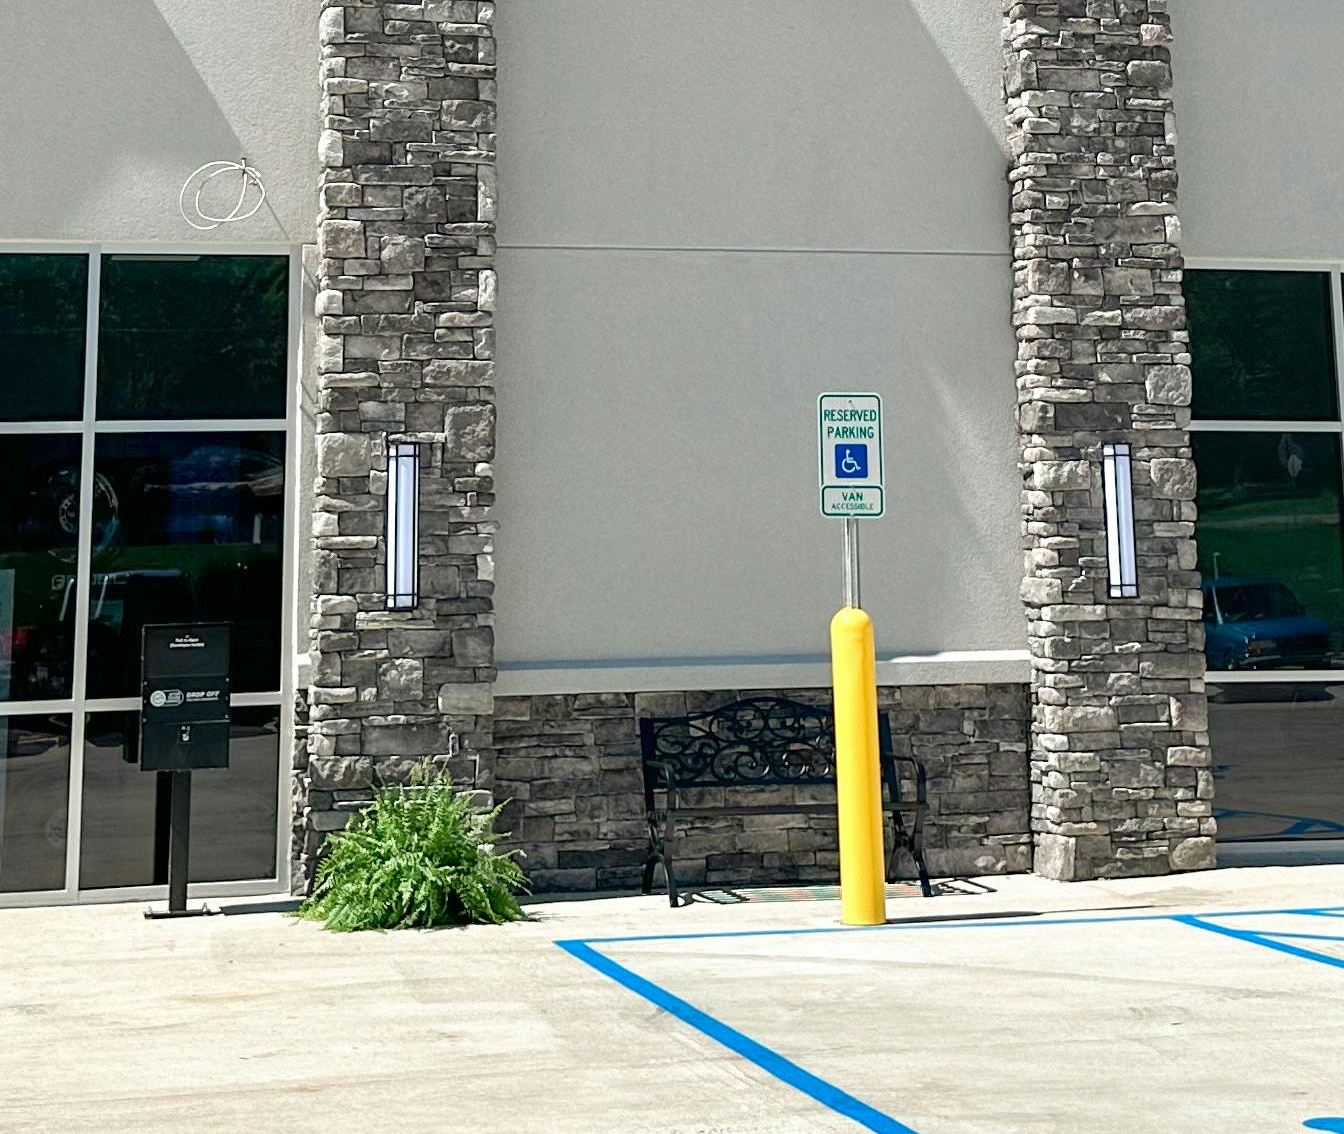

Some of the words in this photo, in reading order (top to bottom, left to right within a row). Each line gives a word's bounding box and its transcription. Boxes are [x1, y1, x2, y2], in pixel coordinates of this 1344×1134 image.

[823, 409, 877, 422] RESERVED
[827, 426, 874, 439] PARKING
[841, 491, 864, 502] VAN
[831, 502, 874, 511] ACCESSIBLE
